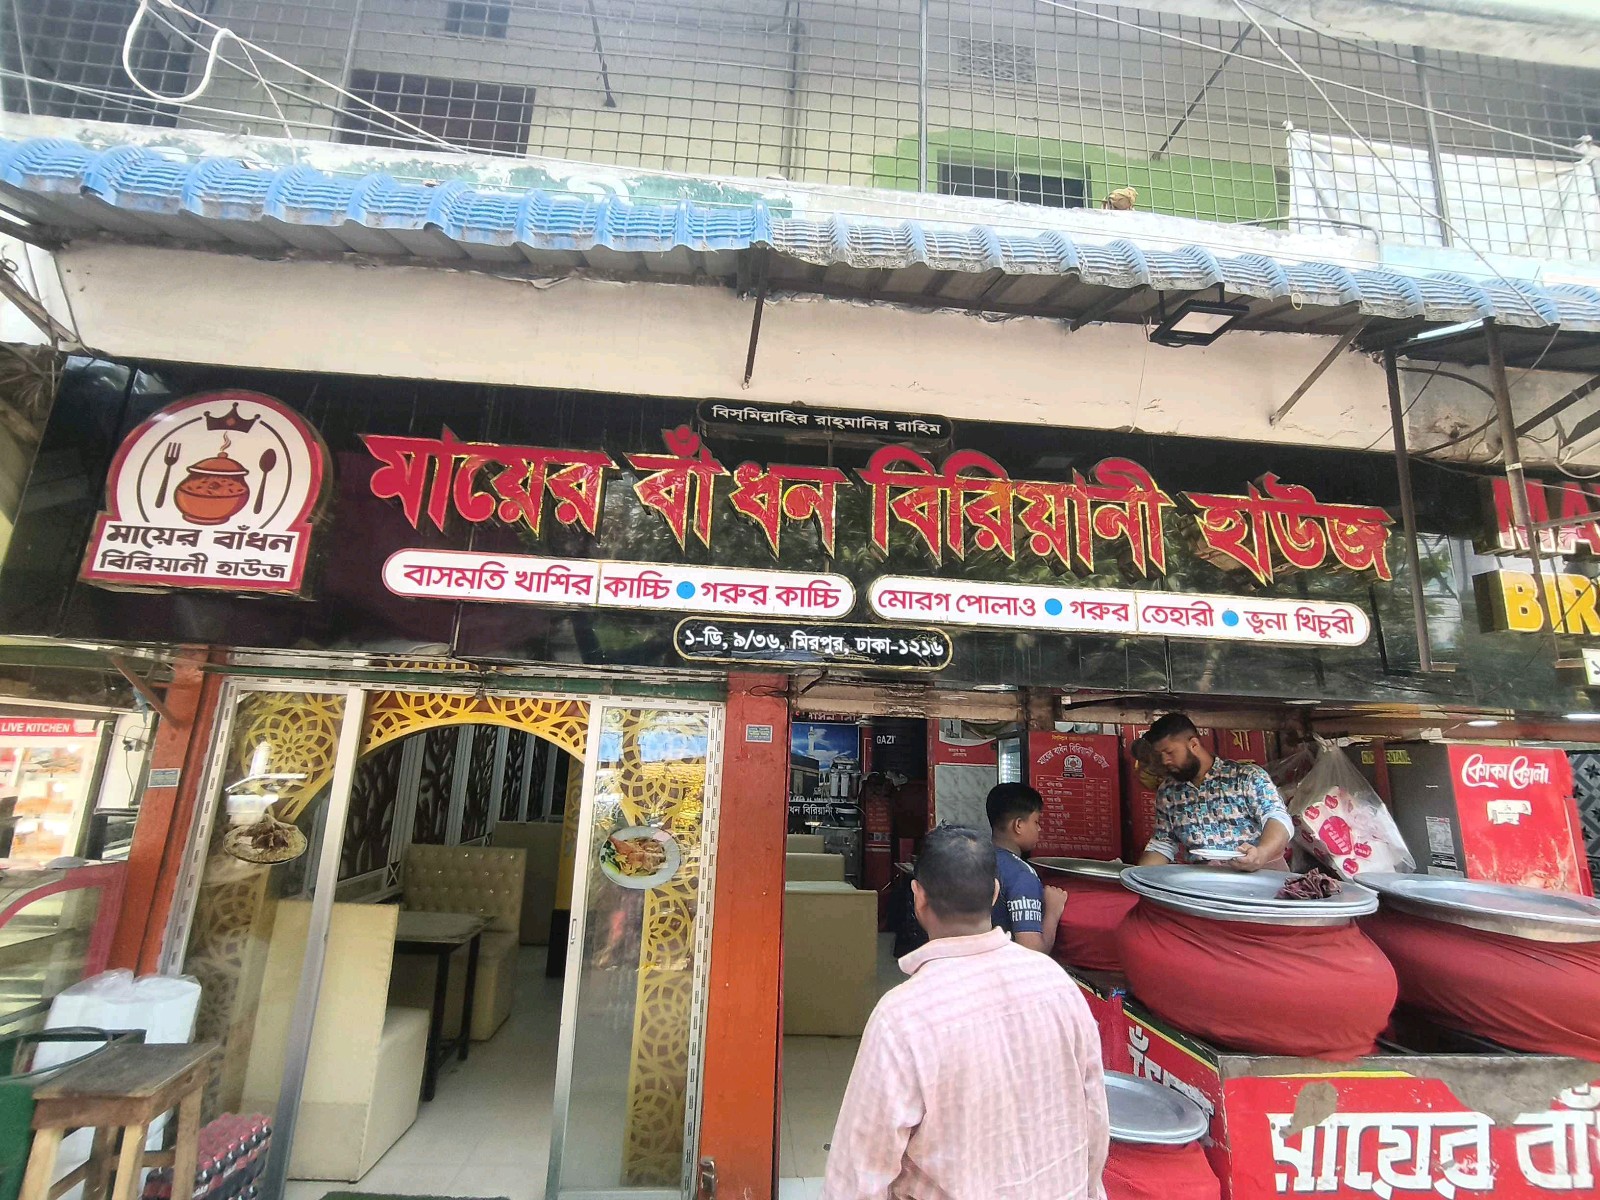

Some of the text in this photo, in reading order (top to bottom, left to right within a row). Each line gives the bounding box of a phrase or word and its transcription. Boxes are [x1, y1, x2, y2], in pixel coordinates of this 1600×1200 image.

[895, 419, 942, 436] রাহিম
[358, 424, 618, 541] মায়ের
[854, 443, 1176, 576] বিরিয়ানী
[1184, 474, 1396, 586] হাউজ
[1493, 478, 1600, 556] MA
[106, 524, 296, 554] মায়ের বাঁধন
[99, 548, 289, 579] বিরিয়ানী হাউজ
[403, 561, 842, 610] বাসমতি খাশির কাচ্চি গরুর কাচ্চি
[877, 587, 1356, 639] মোরগ পোলাও গরুর তেহারী ভূনা খিচুরী
[1500, 568, 1600, 637] BIR
[684, 626, 944, 657] ১-ডি, ৯/৩৬, মিরপুর, ঢাকা-১২১৬
[1, 722, 70, 734] LIVE KITCHEN
[876, 735, 896, 745] GAZI
